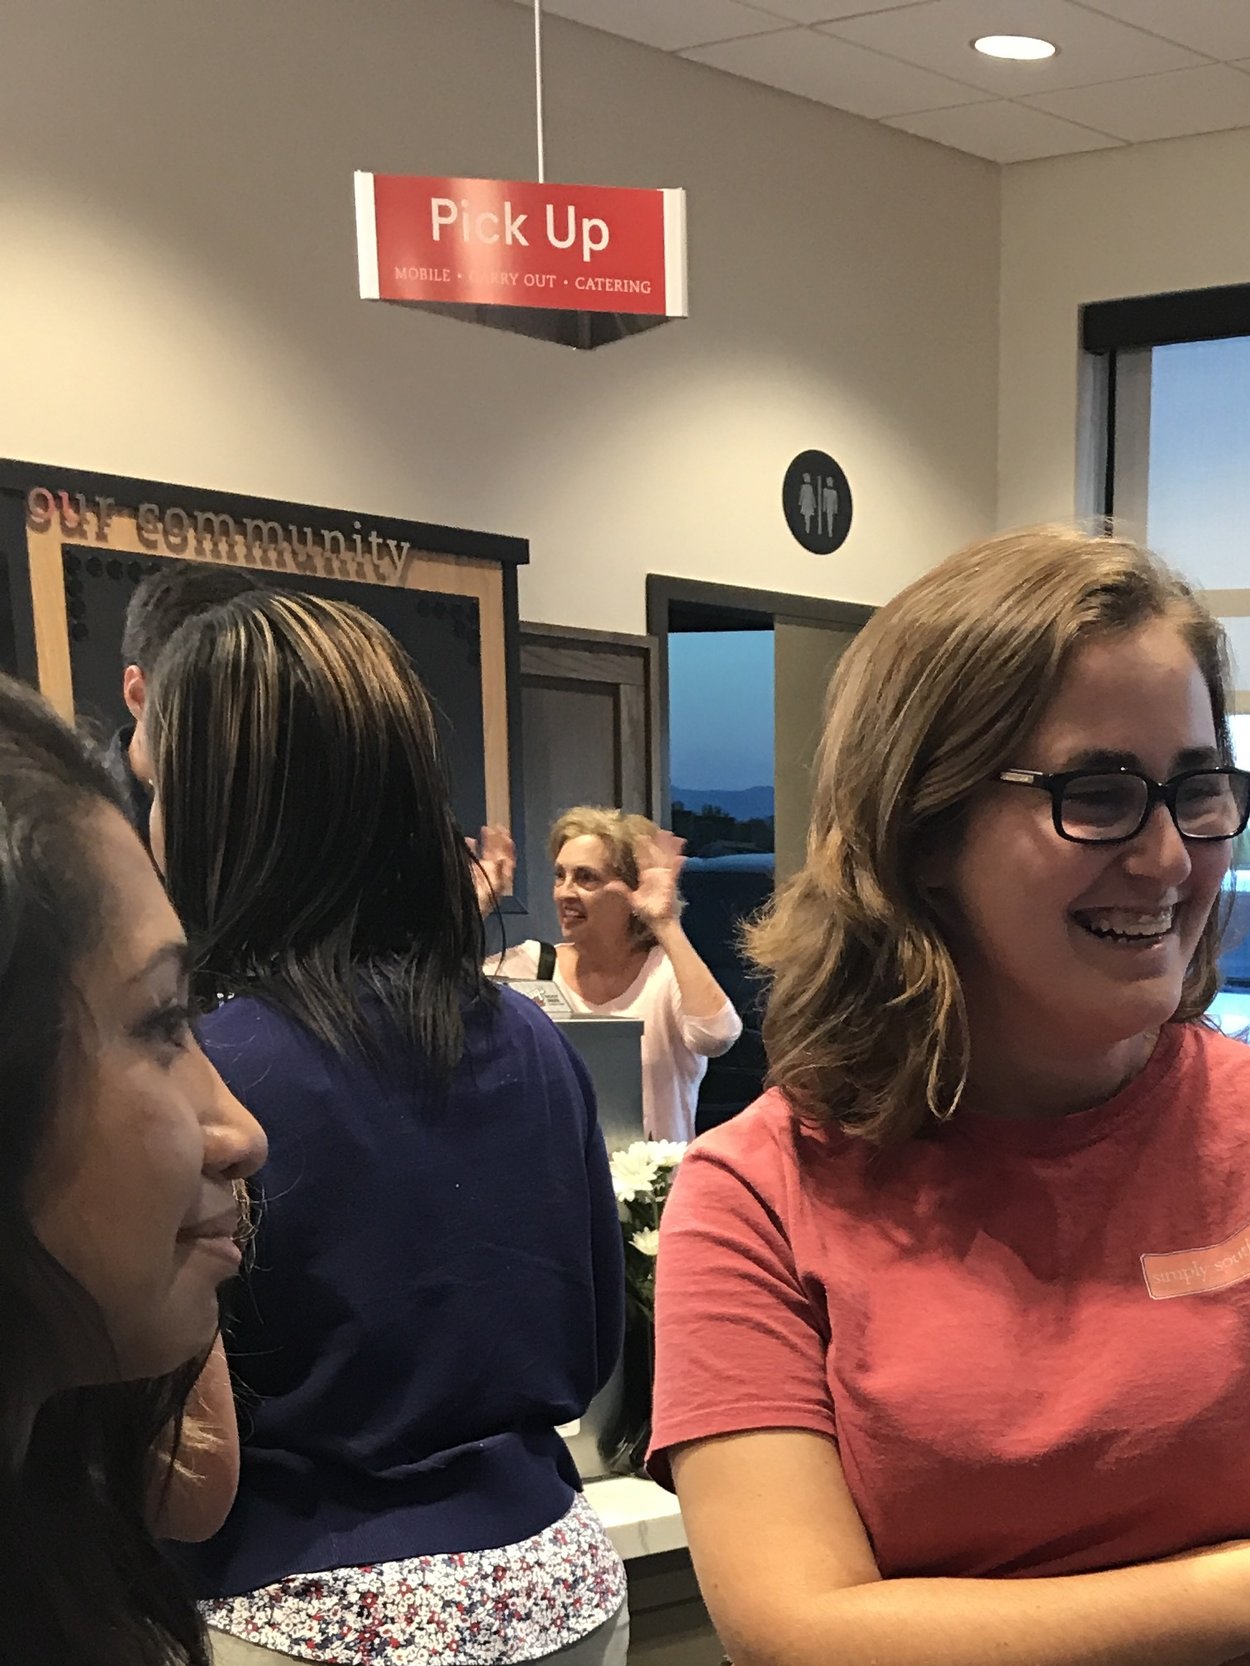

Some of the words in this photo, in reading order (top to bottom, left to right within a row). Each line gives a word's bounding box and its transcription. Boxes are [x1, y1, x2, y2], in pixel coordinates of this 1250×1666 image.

[431, 197, 530, 247] Pick
[546, 203, 610, 263] Up
[394, 265, 452, 282] MOBILE
[523, 273, 557, 288] OUT
[575, 276, 652, 294] CATERING
[27, 486, 116, 530] our
[137, 502, 411, 575] community
[1153, 1261, 1208, 1285] simply
